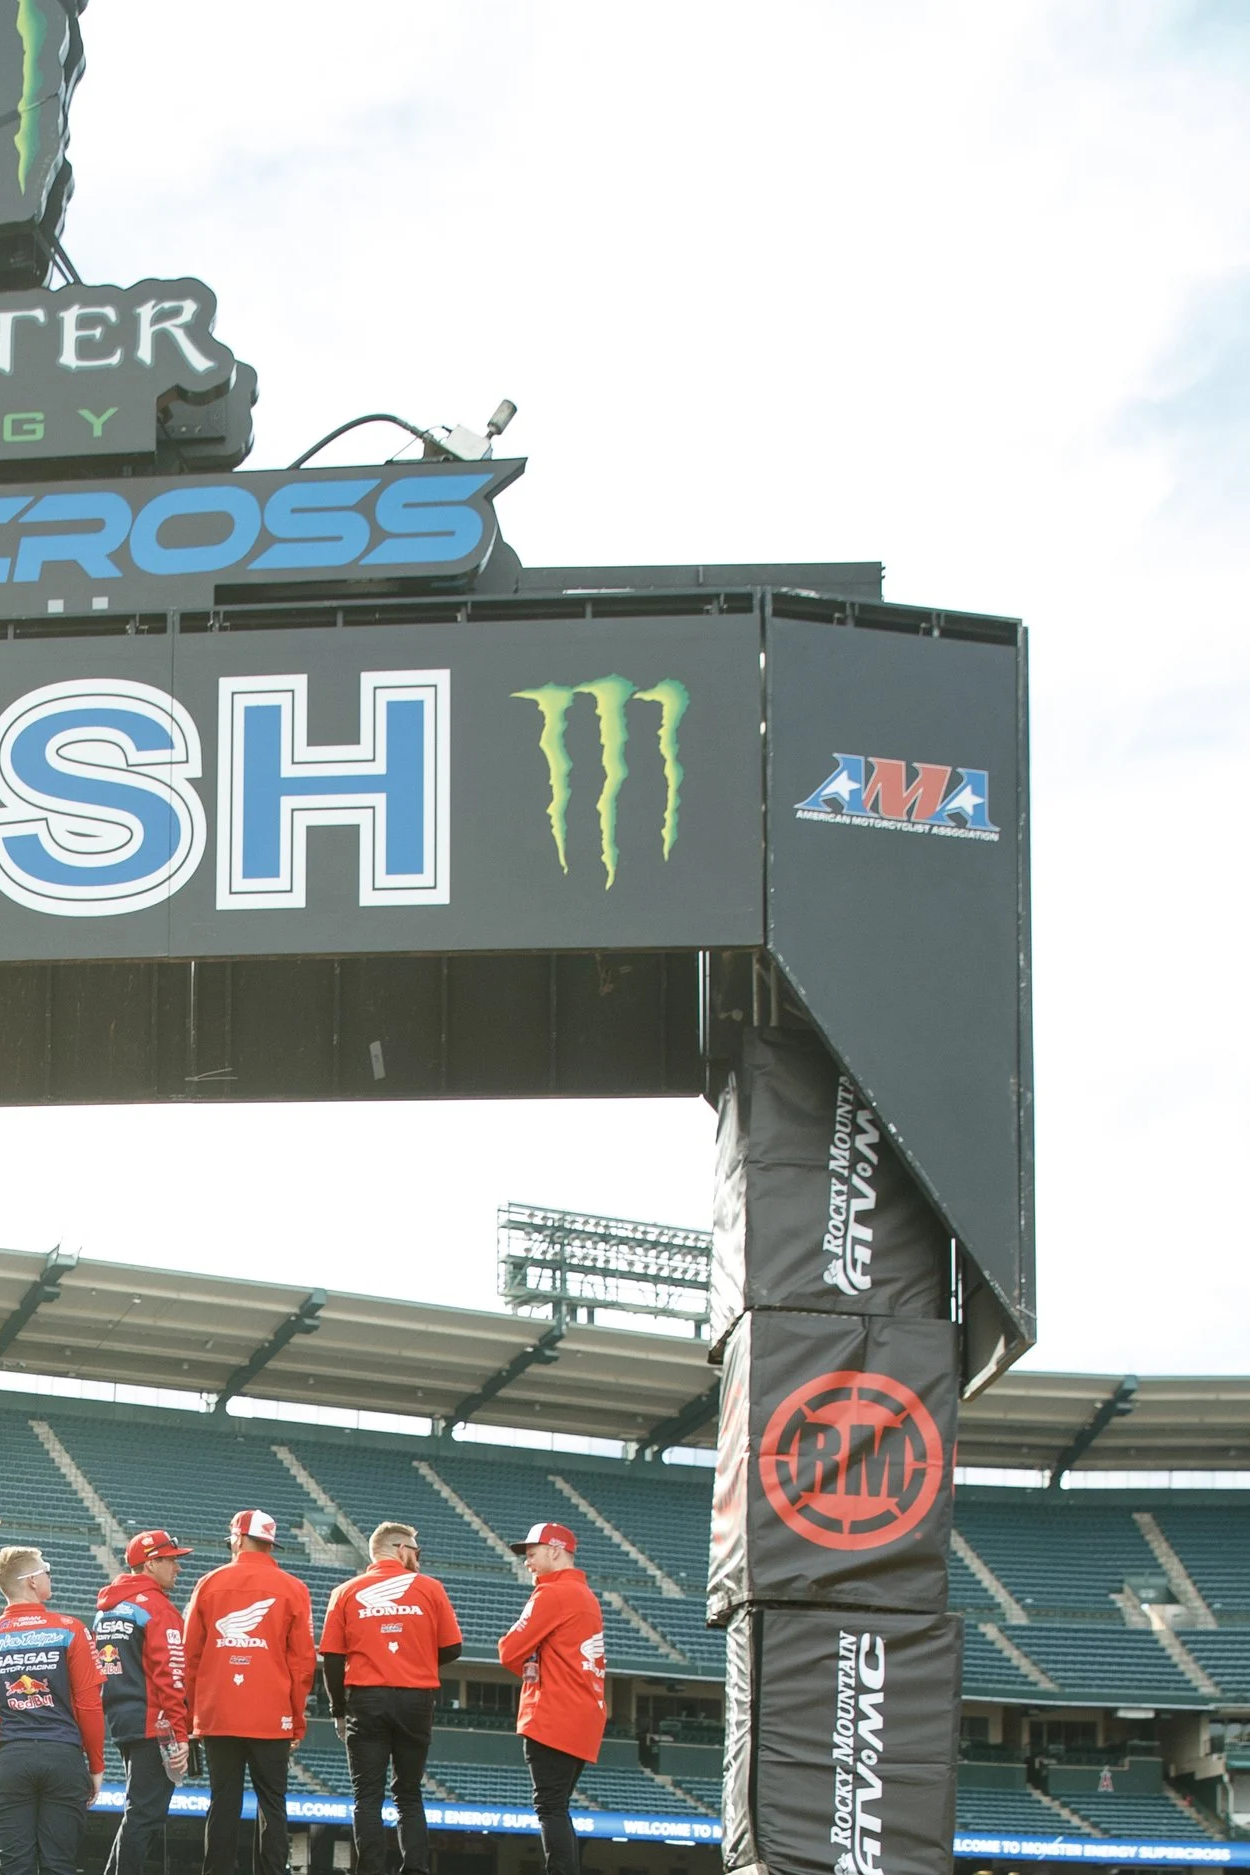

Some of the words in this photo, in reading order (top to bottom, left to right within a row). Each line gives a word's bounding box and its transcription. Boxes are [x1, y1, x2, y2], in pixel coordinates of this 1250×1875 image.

[794, 752, 1001, 831] AMA
[795, 809, 851, 825] AMERICAN
[851, 816, 931, 834] MOTORCYCLIST
[931, 825, 1000, 842] ASSOCIATION
[823, 1177, 848, 1256] ROCKY
[797, 1421, 907, 1499] RM
[358, 1605, 424, 1619] HONDA
[215, 1637, 269, 1650] HONDA
[26, 1664, 57, 1672] RACING
[832, 1631, 857, 1766] MOUNTAIN
[286, 1802, 348, 1818] ELCOME
[445, 1810, 501, 1826] ENERGY
[830, 1766, 853, 1849] ROCKY
[623, 1820, 691, 1837] WELCOME
[692, 1824, 711, 1838] TO
[1002, 1841, 1020, 1854] TO
[1084, 1844, 1139, 1859] ENERGY
[1139, 1846, 1231, 1862] SUPERCROSS
